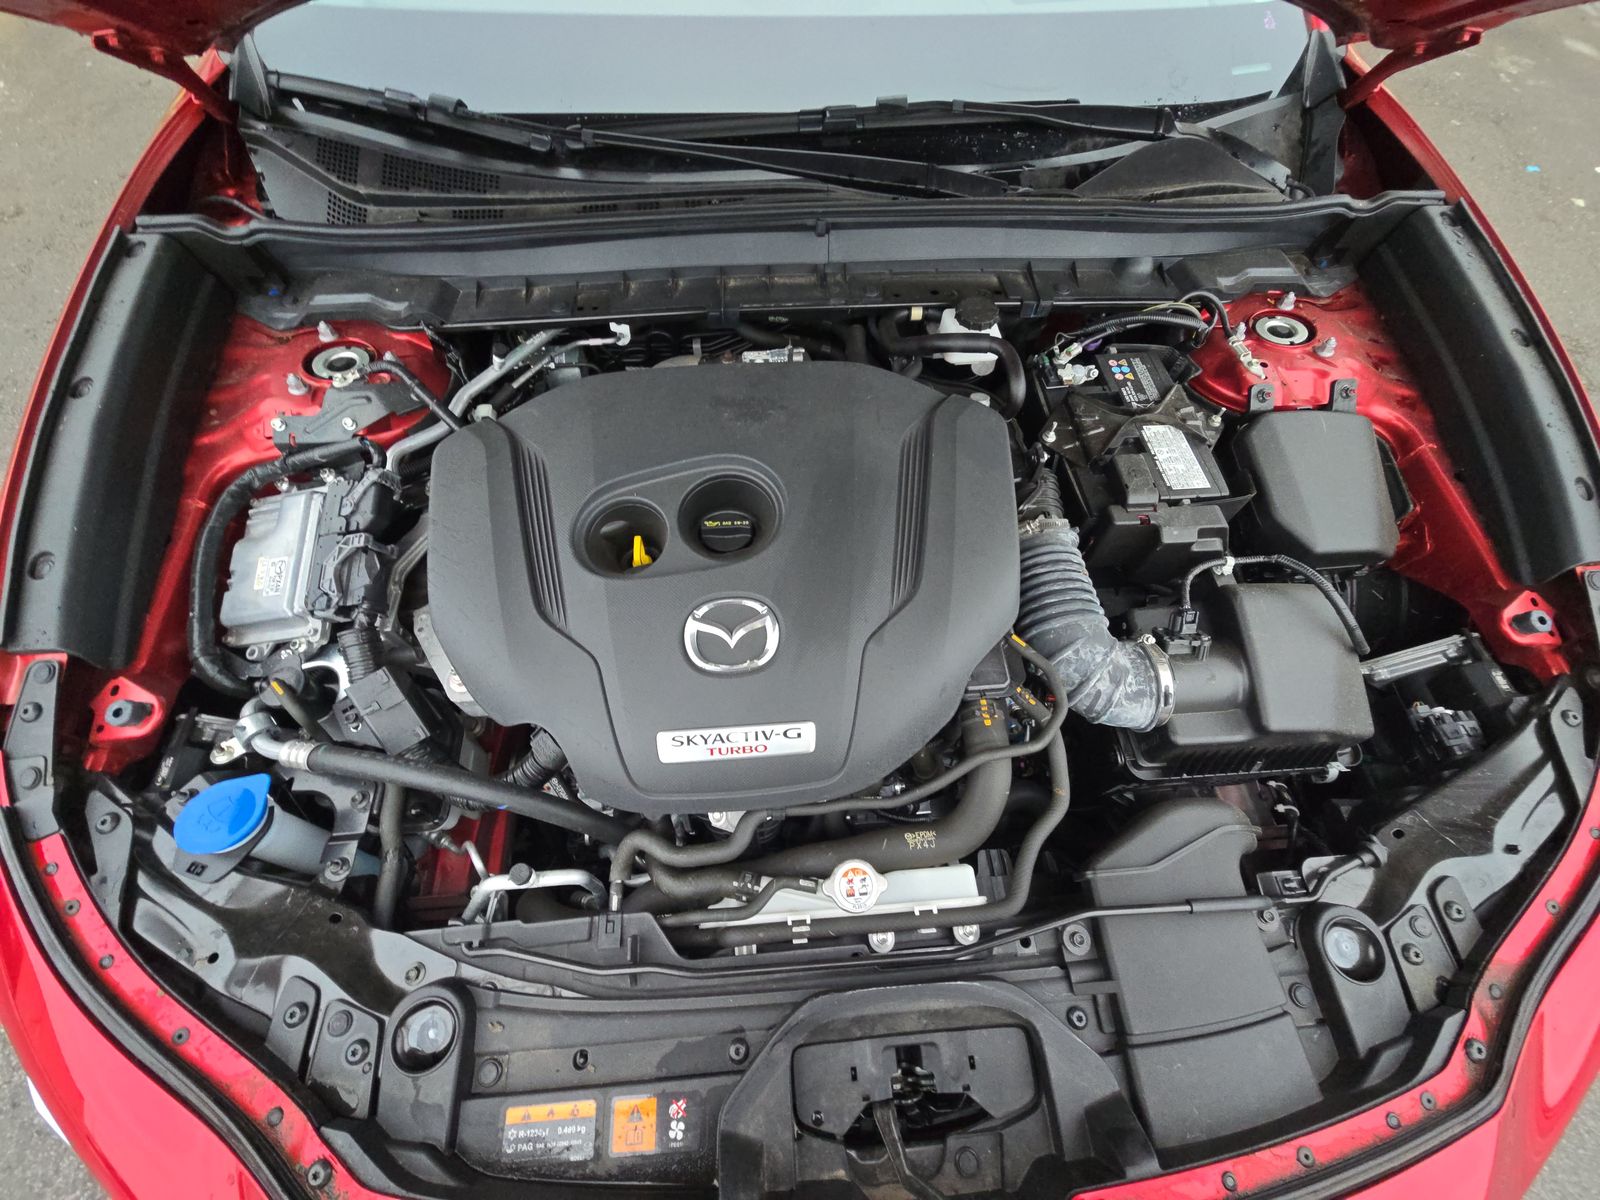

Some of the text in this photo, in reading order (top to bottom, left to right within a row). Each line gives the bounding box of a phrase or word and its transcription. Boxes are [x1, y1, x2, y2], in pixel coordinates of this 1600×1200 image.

[671, 727, 802, 748] SKYACTIV-G
[706, 744, 768, 757] TURBO
[517, 1142, 534, 1152] PAG
